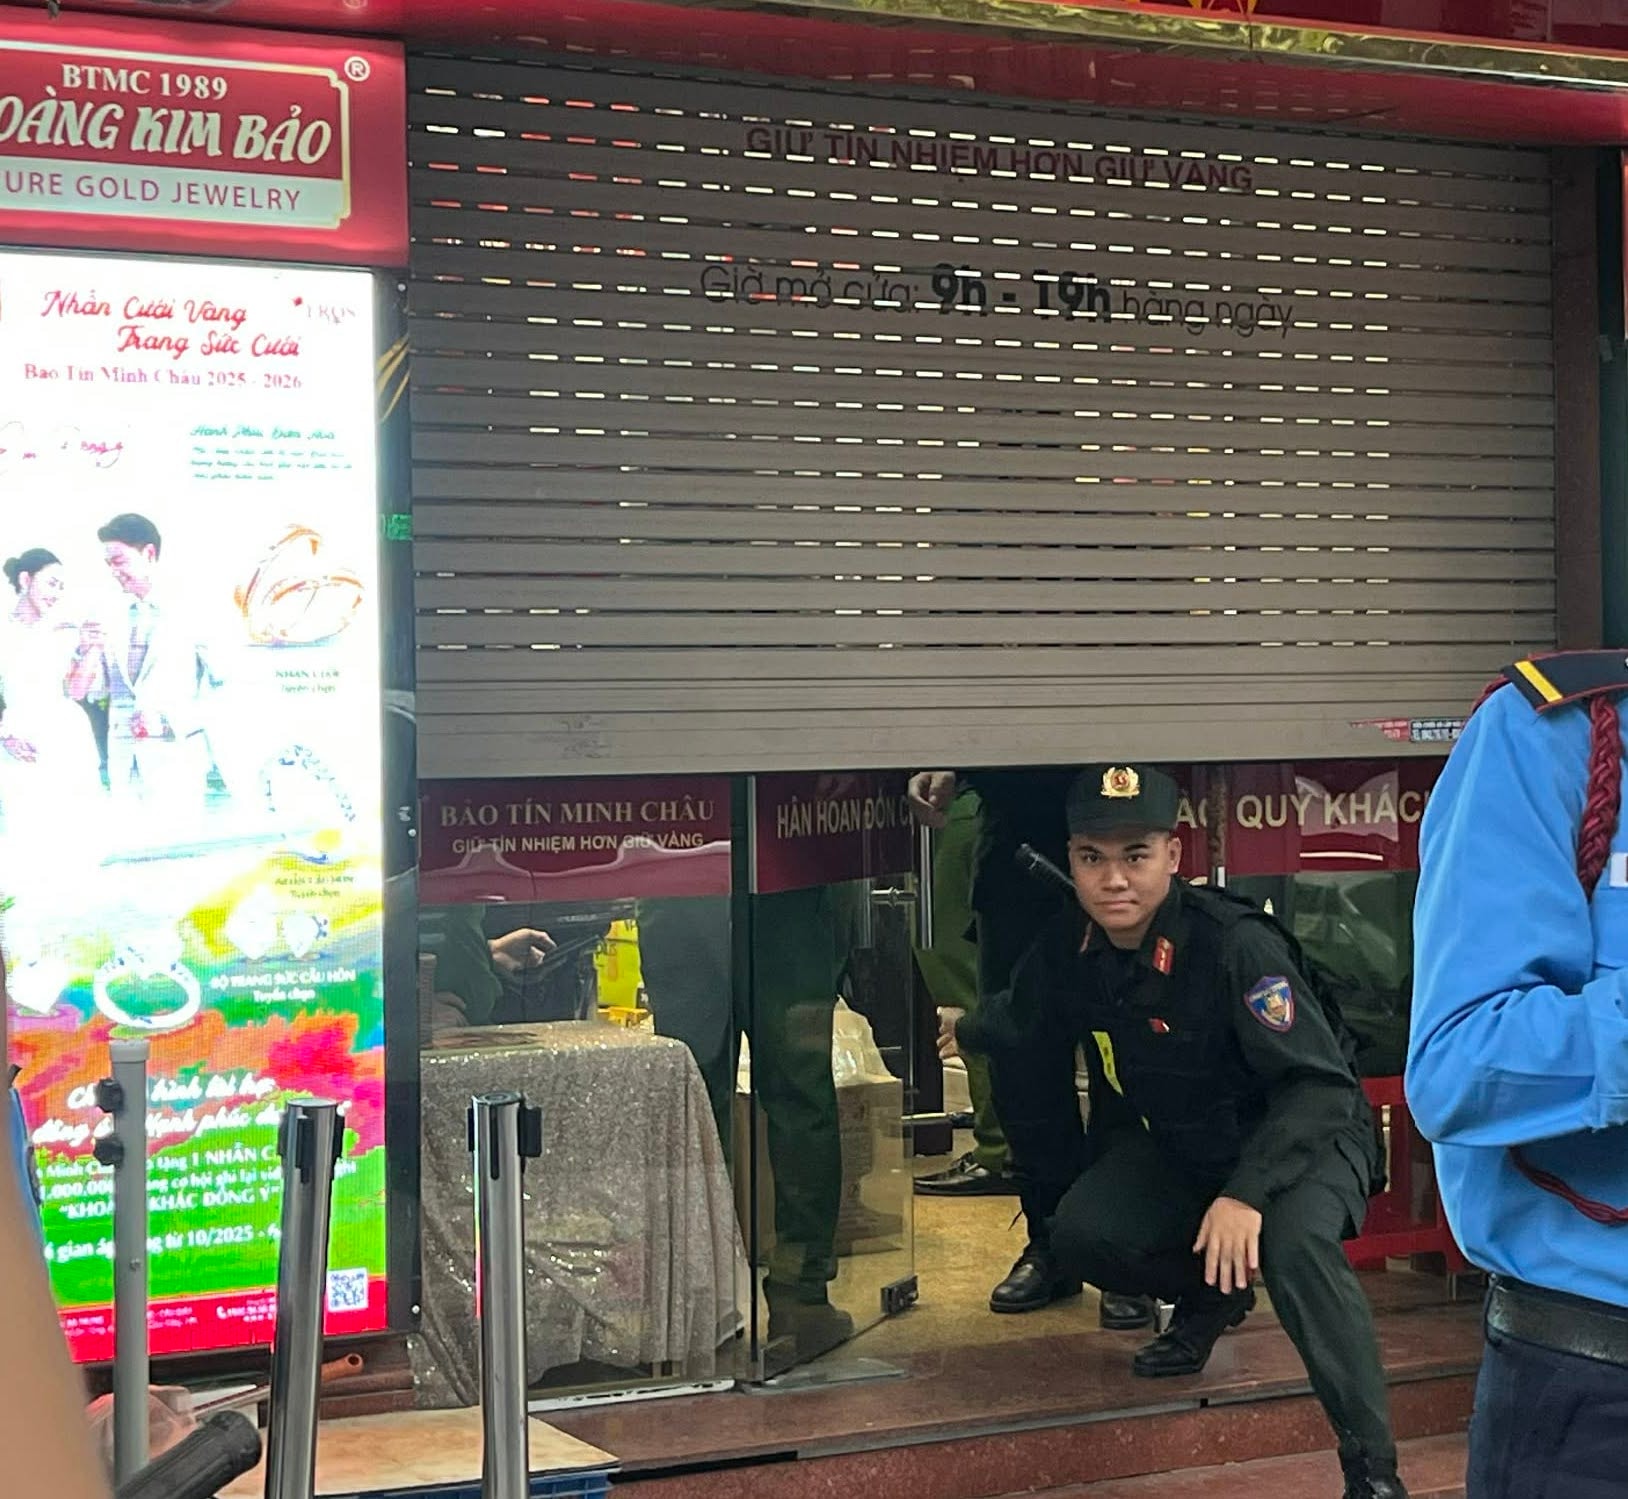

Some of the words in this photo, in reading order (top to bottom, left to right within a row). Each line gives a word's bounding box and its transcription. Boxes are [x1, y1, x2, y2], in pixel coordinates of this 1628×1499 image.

[62, 64, 150, 94] BTMC
[160, 72, 228, 100] 1989
[131, 106, 223, 156] KIM
[233, 105, 332, 164] BẢO
[76, 174, 160, 201] GOLD
[171, 182, 301, 211] JEWELRY
[931, 263, 988, 316] 9h
[1033, 270, 1111, 323] 19h
[117, 325, 190, 360] Trang
[507, 798, 552, 825] TÍN
[559, 801, 632, 825] MINH
[640, 794, 714, 823] CHÂU
[817, 798, 860, 835] HOAN
[1324, 785, 1429, 826] KHÁC
[522, 834, 575, 854] NHIỆM
[580, 835, 617, 850] HƠN
[657, 830, 703, 848] VÀNG
